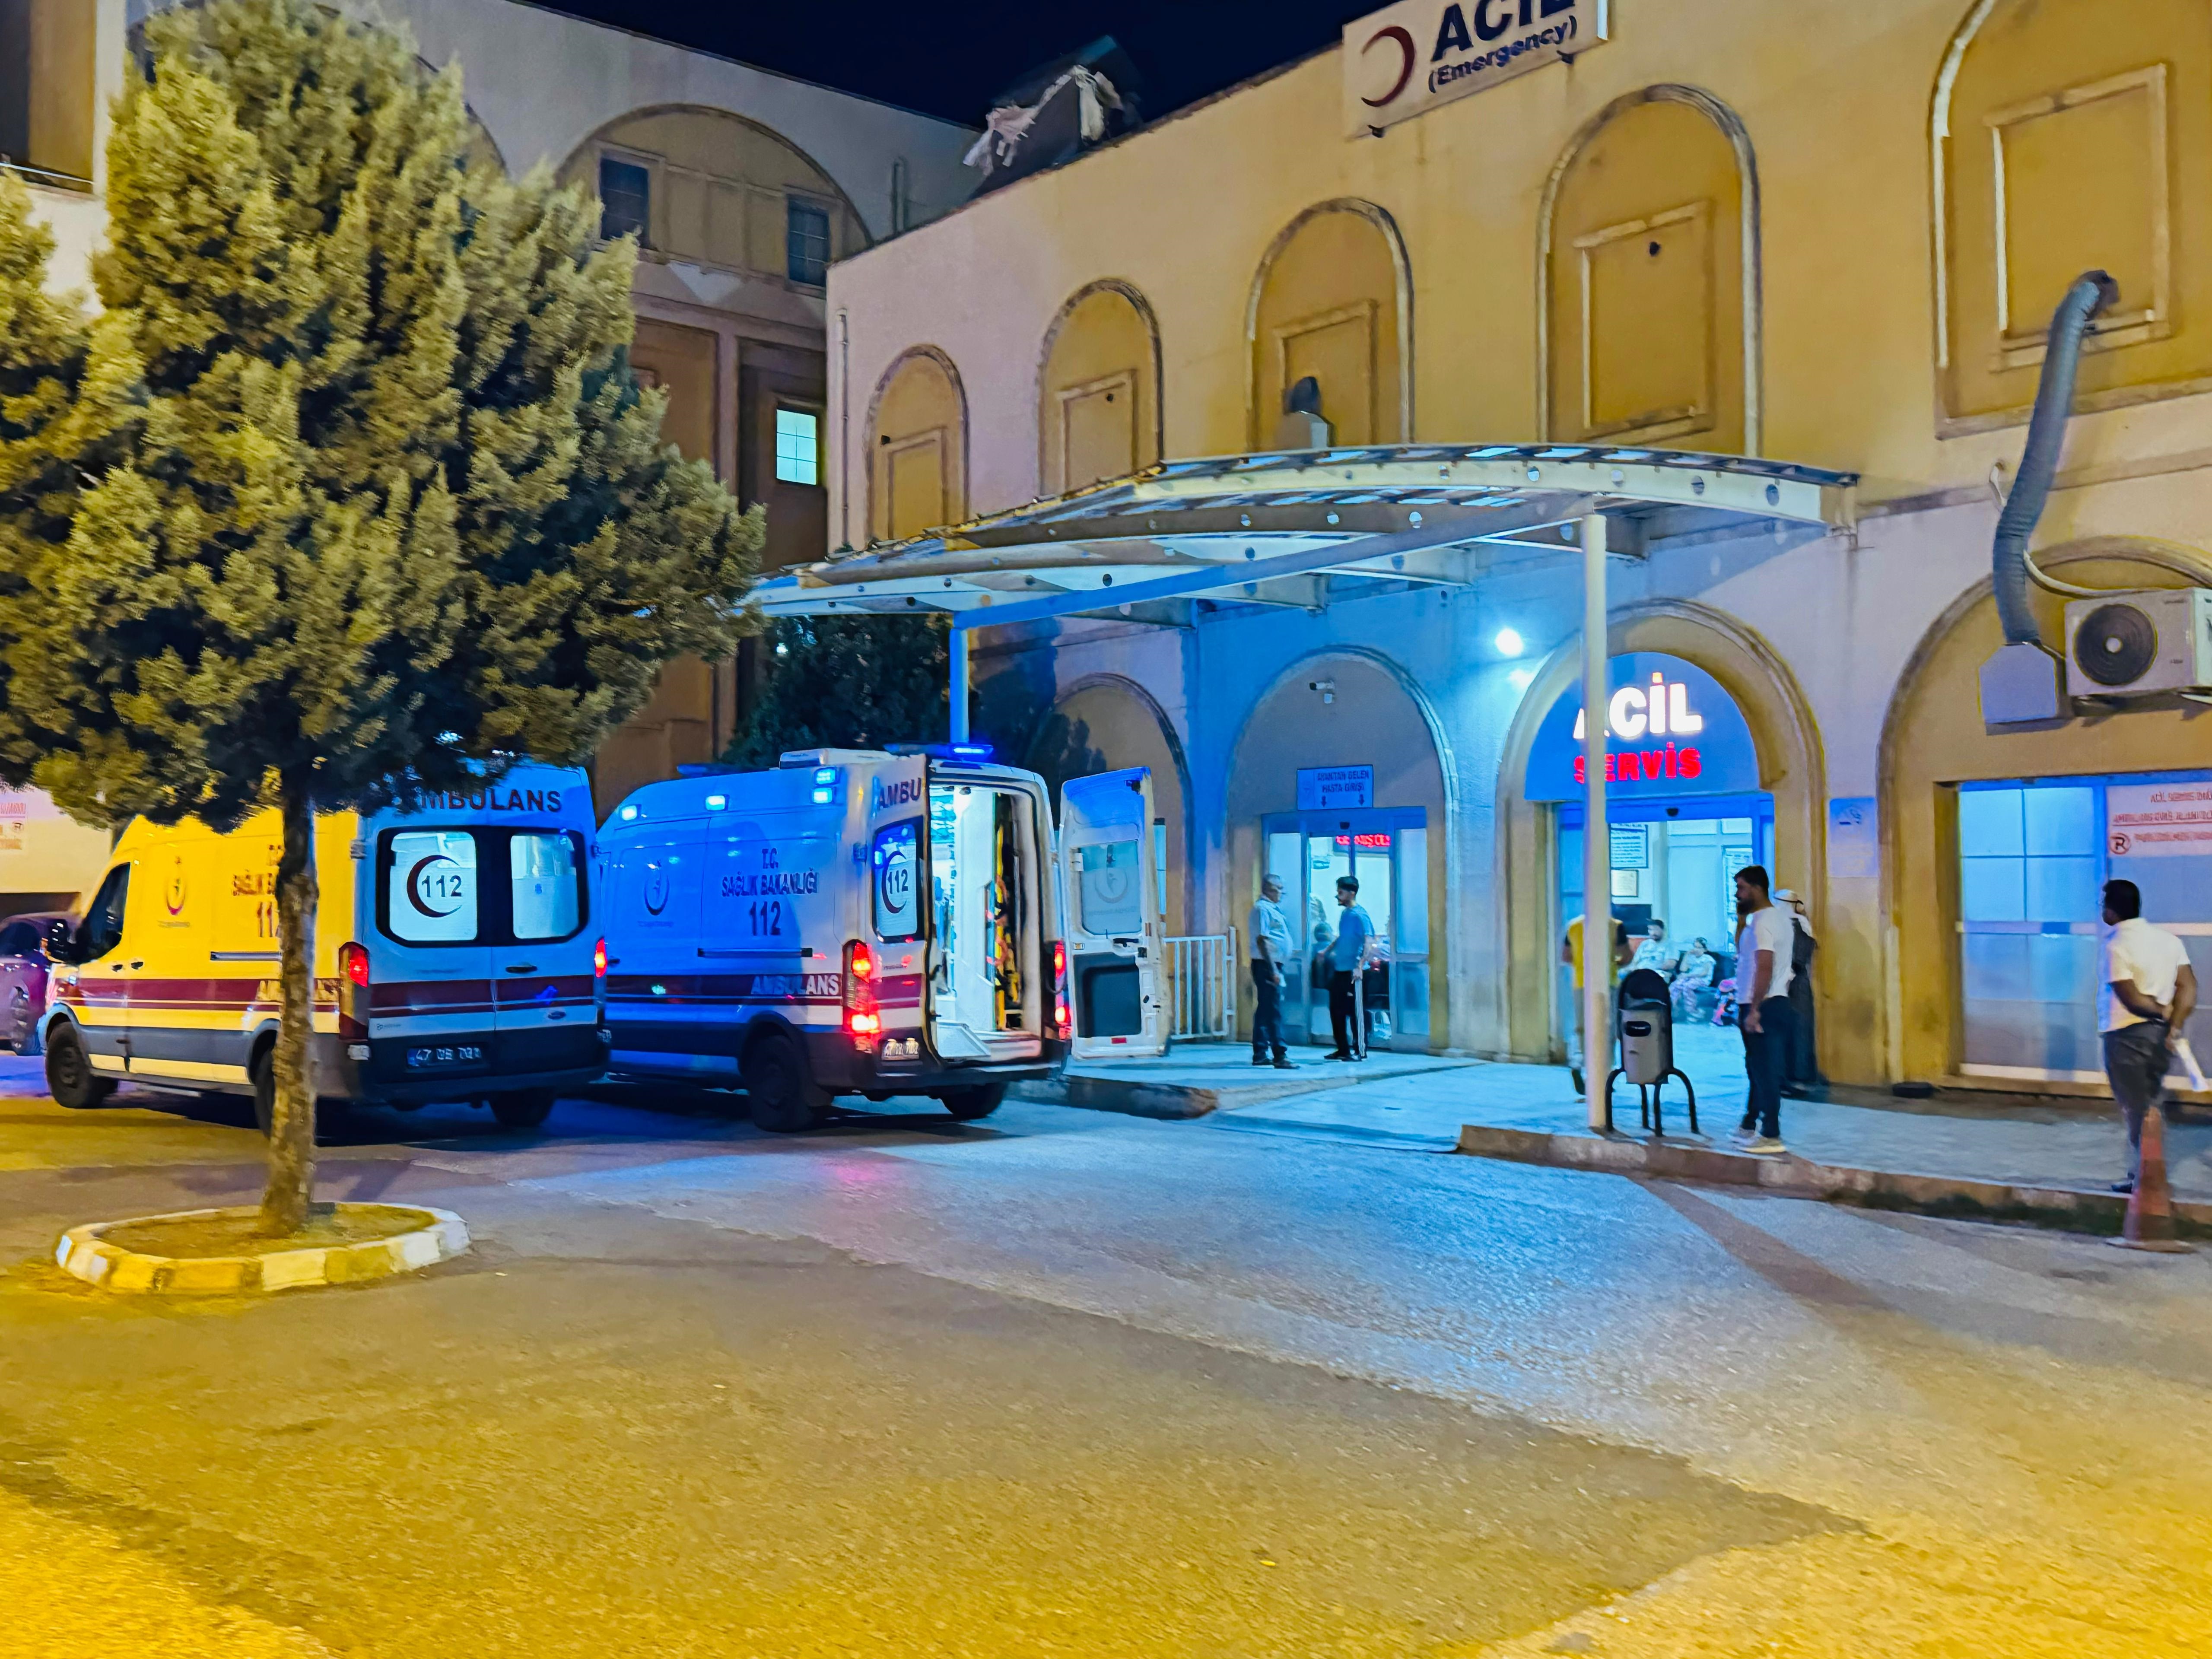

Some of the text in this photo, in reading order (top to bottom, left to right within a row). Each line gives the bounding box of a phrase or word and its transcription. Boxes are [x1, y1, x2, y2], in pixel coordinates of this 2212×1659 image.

[1428, 15, 1577, 93] (Emergency)
[421, 788, 561, 813] MBULANS
[422, 875, 462, 898] 112
[888, 869, 909, 894] 112
[257, 902, 279, 938] 11
[750, 901, 781, 936] 112
[751, 975, 839, 995] AMBULANS
